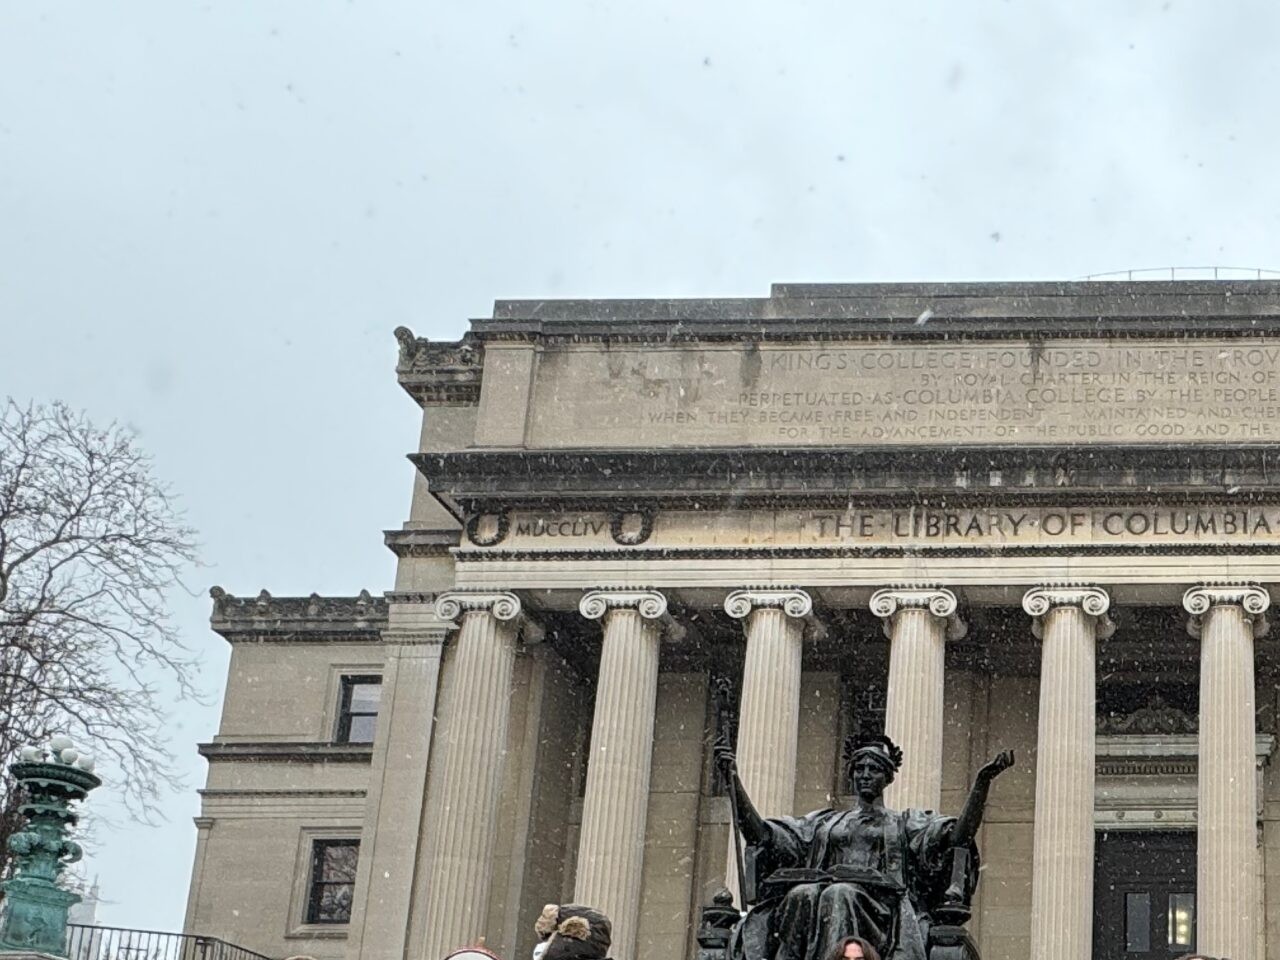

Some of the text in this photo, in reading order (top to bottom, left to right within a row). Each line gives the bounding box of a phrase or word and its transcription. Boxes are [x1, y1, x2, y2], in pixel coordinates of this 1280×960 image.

[860, 352, 972, 369] COLLEGE
[986, 351, 1100, 368] FOUNDED
[1118, 350, 1141, 368] IN
[1154, 350, 1204, 367] THE
[920, 373, 942, 386] BY
[954, 373, 1010, 386] ROYAL
[1020, 372, 1102, 386] CHARTER
[1112, 372, 1130, 384] IN
[1141, 372, 1177, 384] THE
[1189, 371, 1240, 384] REIGN
[1252, 371, 1276, 383] OF
[738, 391, 863, 407] PERPETUATED
[872, 392, 893, 405] AS
[903, 389, 1016, 405] COLUMBIA
[1025, 388, 1126, 403] COLLEGE
[1136, 389, 1157, 402] BY
[1169, 389, 1203, 402] THE
[1214, 388, 1277, 401] PEOPLE
[649, 411, 698, 424] WHEN
[707, 411, 750, 423] THEY
[759, 411, 823, 423] BECAME
[834, 410, 873, 423] FREE
[881, 410, 918, 422] AND
[928, 409, 1045, 421] INDEPENDENT
[1084, 407, 1187, 420] MAINTAINED
[1197, 407, 1232, 419] AND
[778, 427, 808, 439] FOR
[819, 427, 851, 438] THE
[860, 426, 986, 438] ADVANCEMENT
[994, 425, 1016, 437] OF
[1025, 425, 1057, 437] THE
[1068, 425, 1124, 437] PUBLIC
[1135, 424, 1185, 436] GOOD
[1194, 424, 1229, 436] AND
[1240, 423, 1273, 435] THE
[812, 514, 875, 538] THE
[894, 513, 1028, 537] LIBRARY
[1042, 512, 1086, 536] OF
[1102, 511, 1273, 536] COLUMBIA
